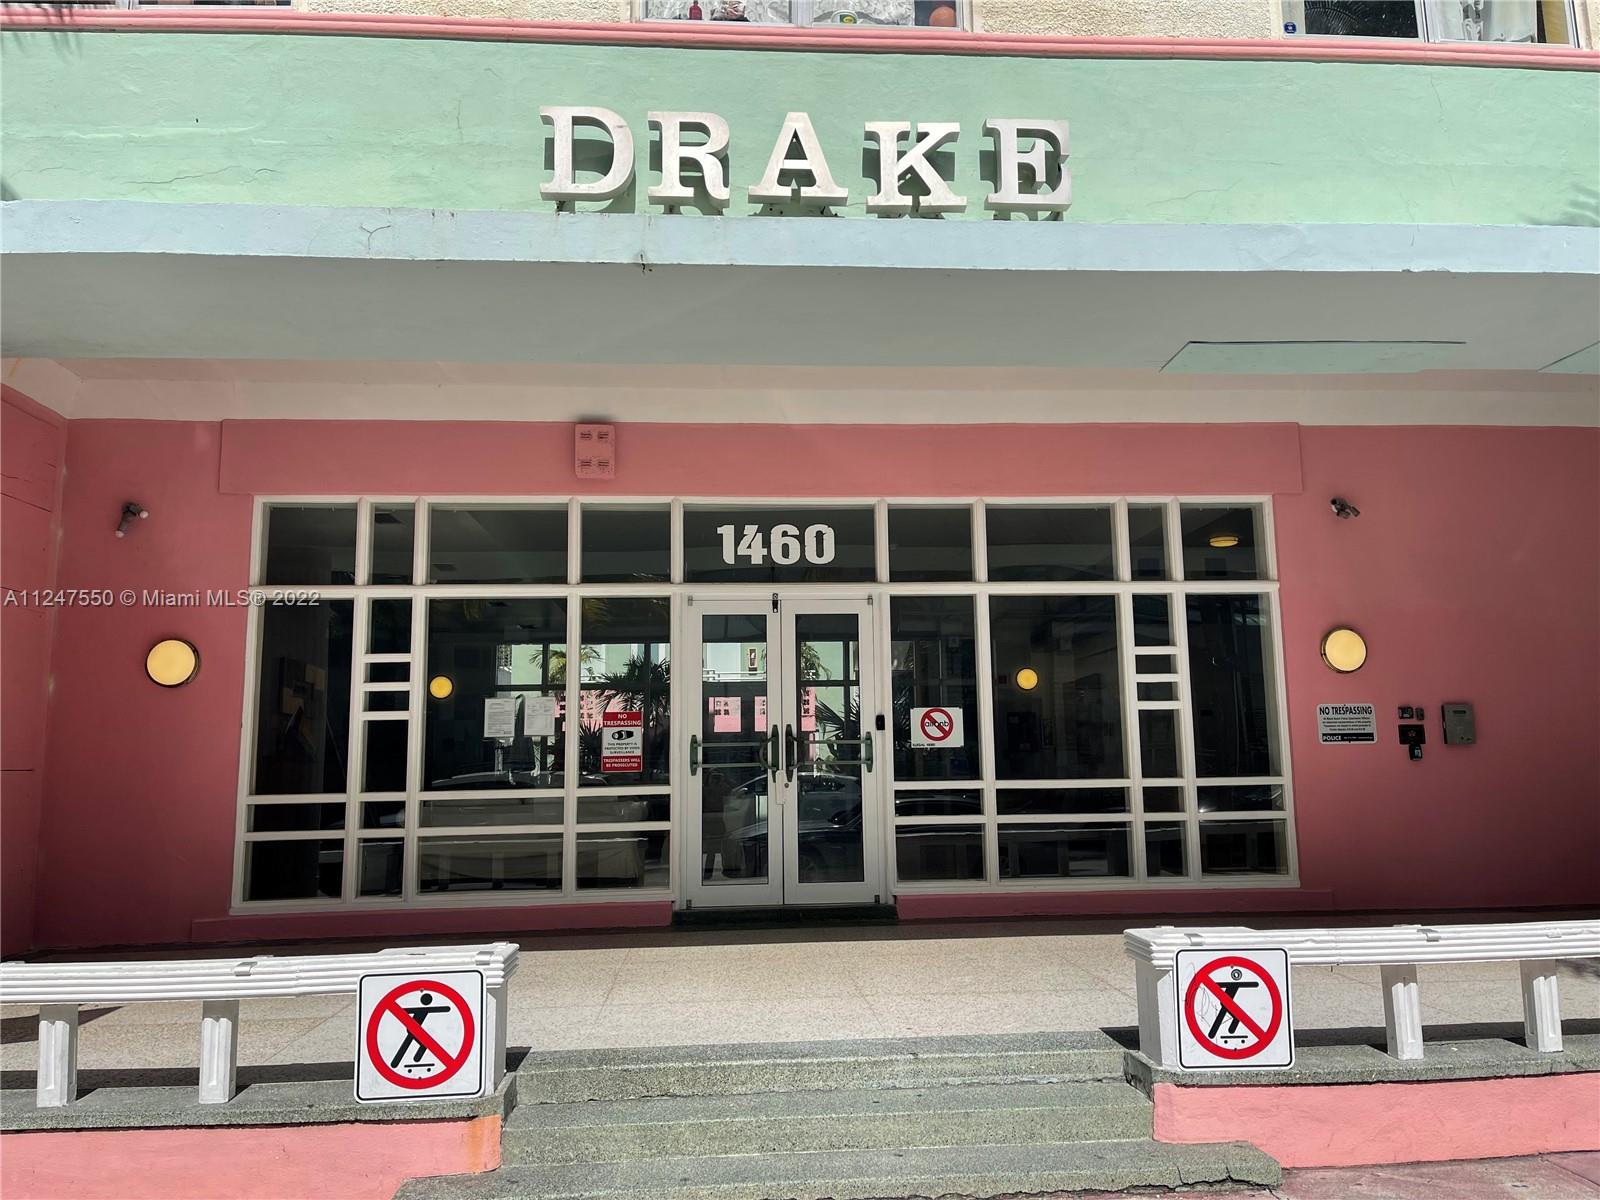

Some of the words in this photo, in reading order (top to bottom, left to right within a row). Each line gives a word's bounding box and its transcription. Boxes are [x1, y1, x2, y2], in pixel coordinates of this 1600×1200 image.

[539, 106, 1072, 212] DRAKE
[716, 523, 836, 565] 1460
[1320, 706, 1330, 715] NO
[1332, 706, 1372, 714] TRESPASSING
